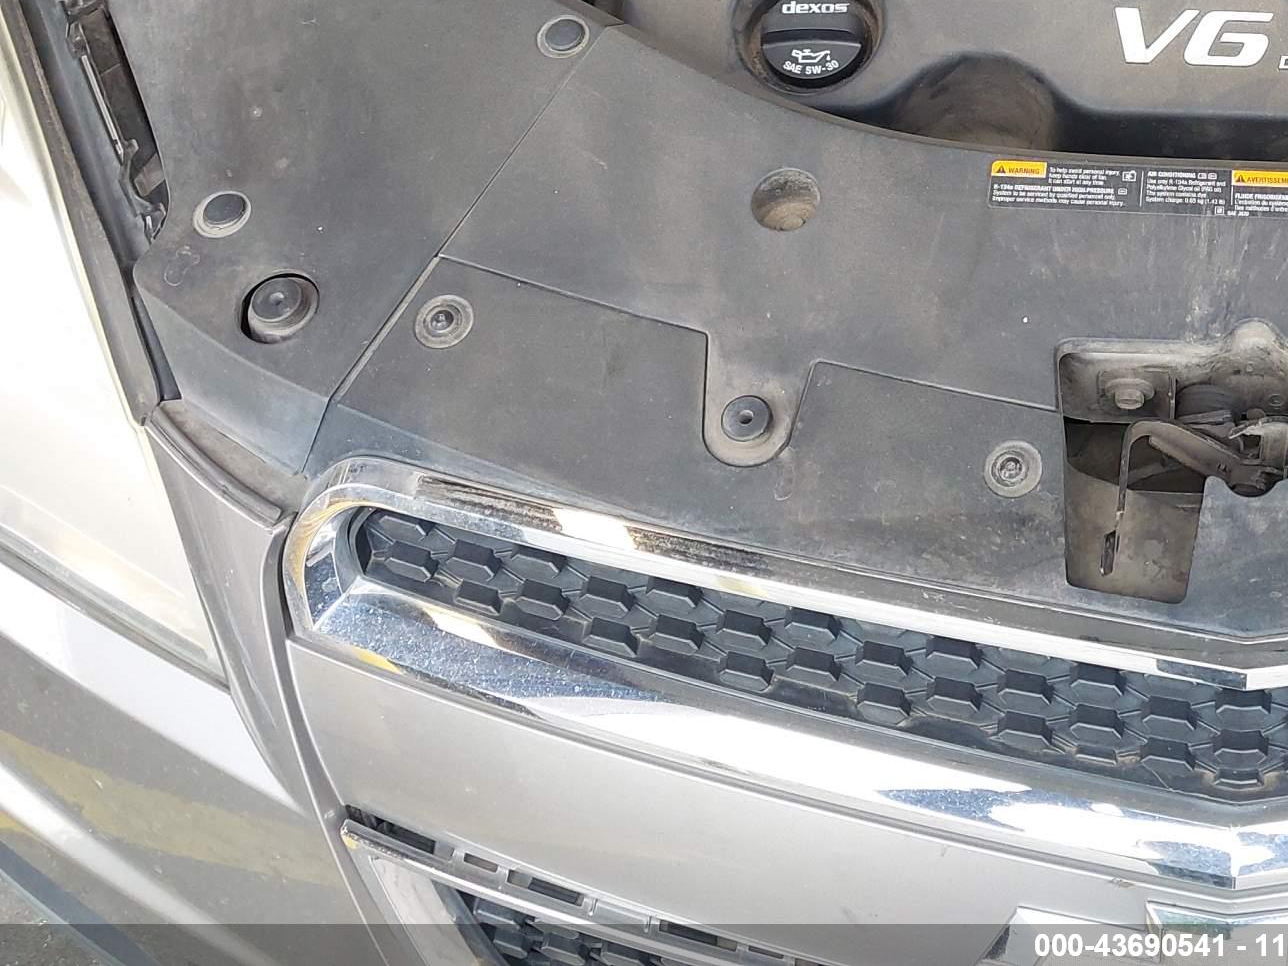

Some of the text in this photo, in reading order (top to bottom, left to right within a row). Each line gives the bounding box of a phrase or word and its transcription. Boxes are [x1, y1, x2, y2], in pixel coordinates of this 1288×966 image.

[782, 1, 850, 14] dexos
[1114, 7, 1274, 67] V6
[782, 60, 840, 75] SAE 5W-30
[1008, 166, 1040, 175] WARNING
